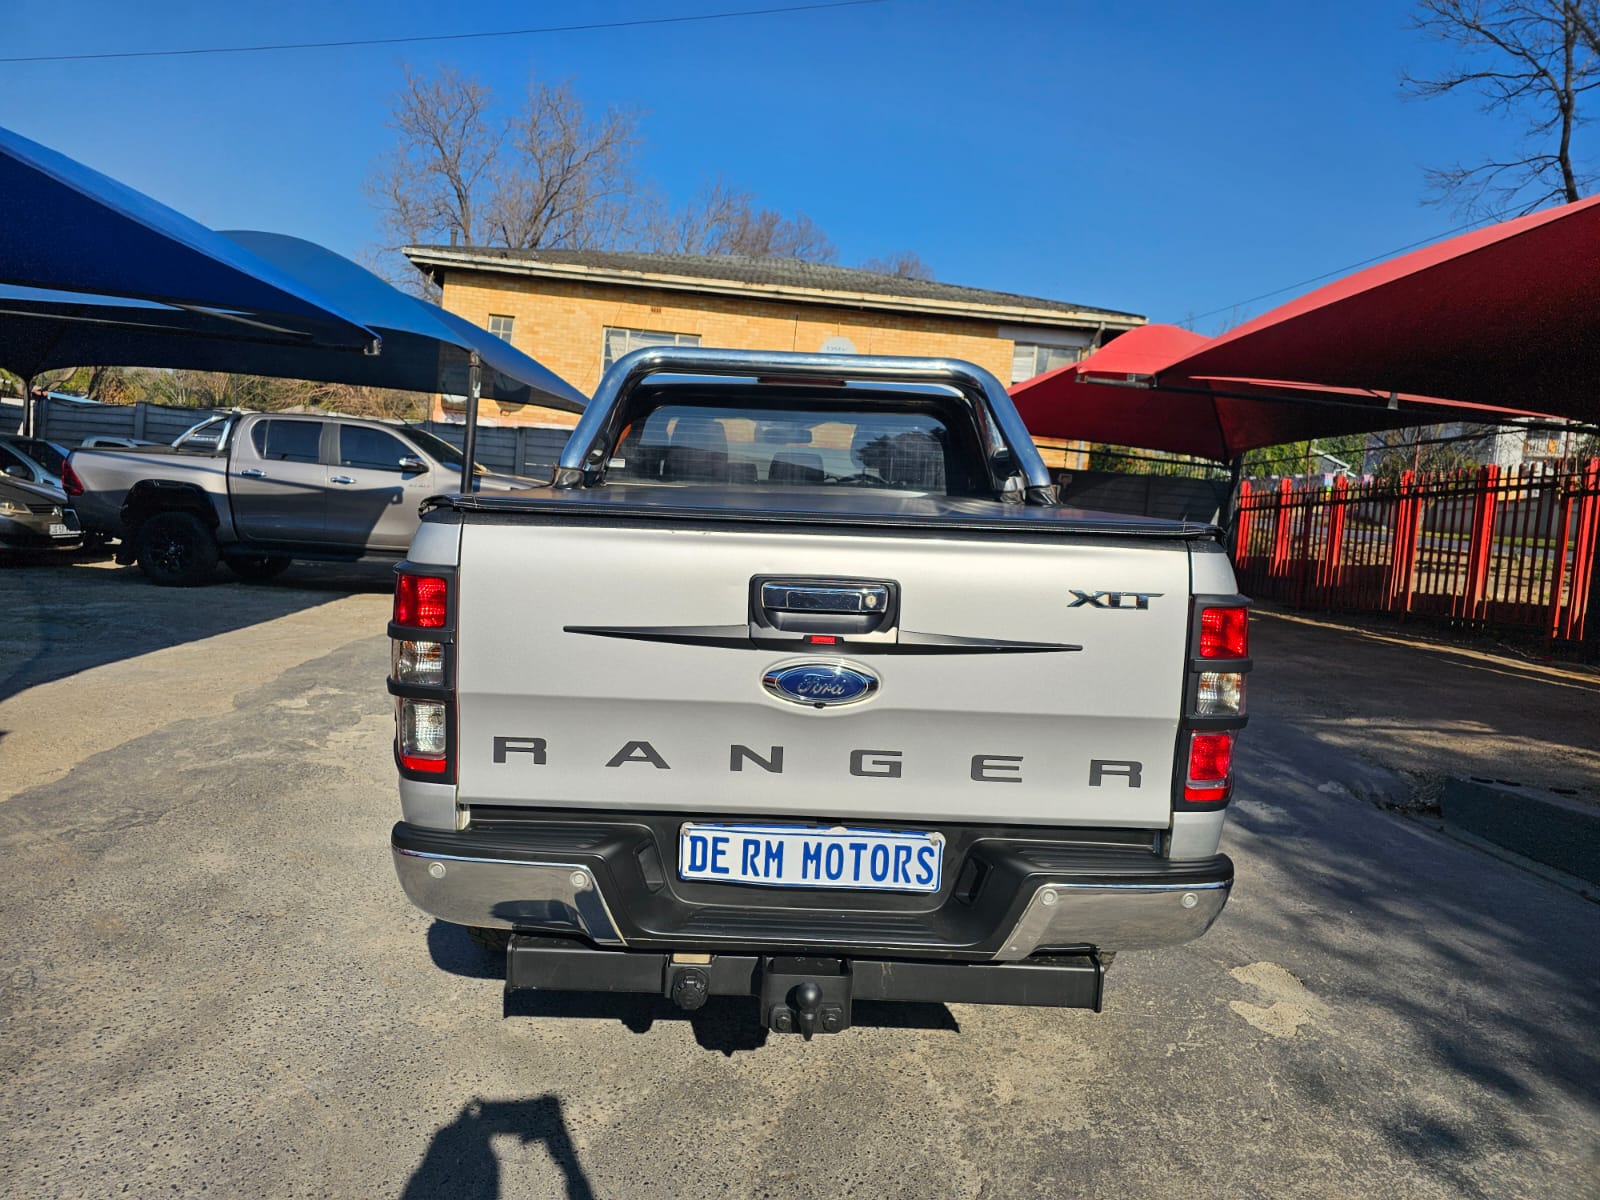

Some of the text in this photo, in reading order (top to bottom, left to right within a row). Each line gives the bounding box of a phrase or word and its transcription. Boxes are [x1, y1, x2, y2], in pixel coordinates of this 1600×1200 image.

[1066, 590, 1164, 610] XLT
[797, 673, 846, 695] Ford
[492, 736, 1143, 788] RANGER
[688, 835, 936, 885] DE RM MOTORS
